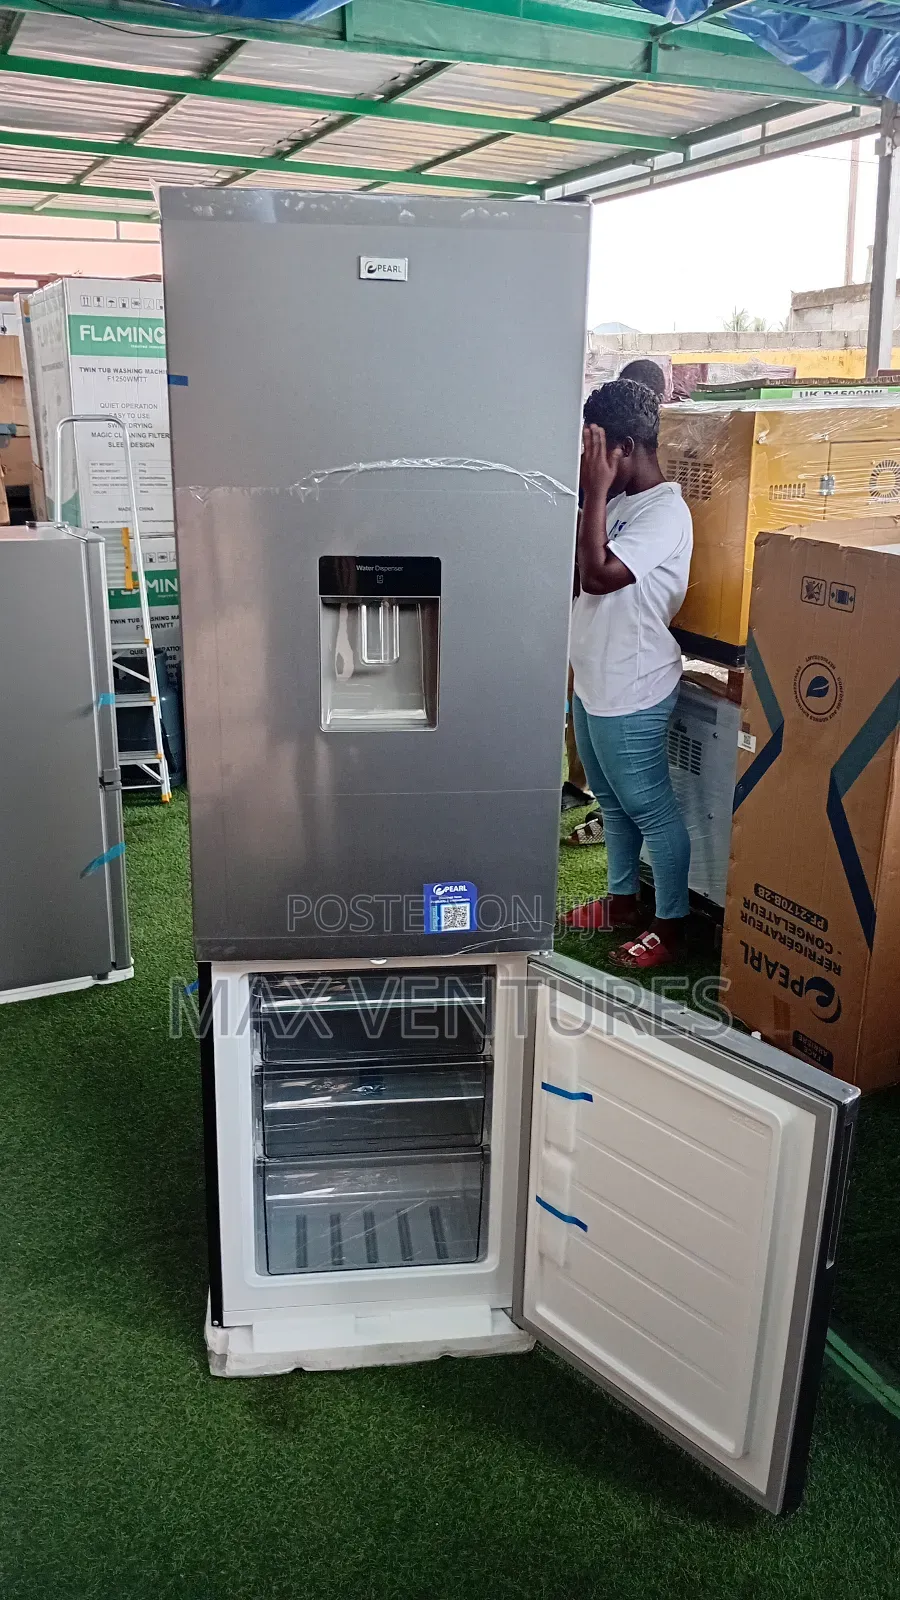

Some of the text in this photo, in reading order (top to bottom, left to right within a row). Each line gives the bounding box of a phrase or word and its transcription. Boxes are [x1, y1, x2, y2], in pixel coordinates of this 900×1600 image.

[377, 264, 402, 273] PEARL
[444, 884, 468, 893] PEARL
[758, 886, 825, 928] PF-2170B-2B
[740, 910, 842, 976] RÉFRIGÉRATEUR
[743, 896, 834, 955] CONGELATEUR
[740, 940, 804, 997] PEARL
